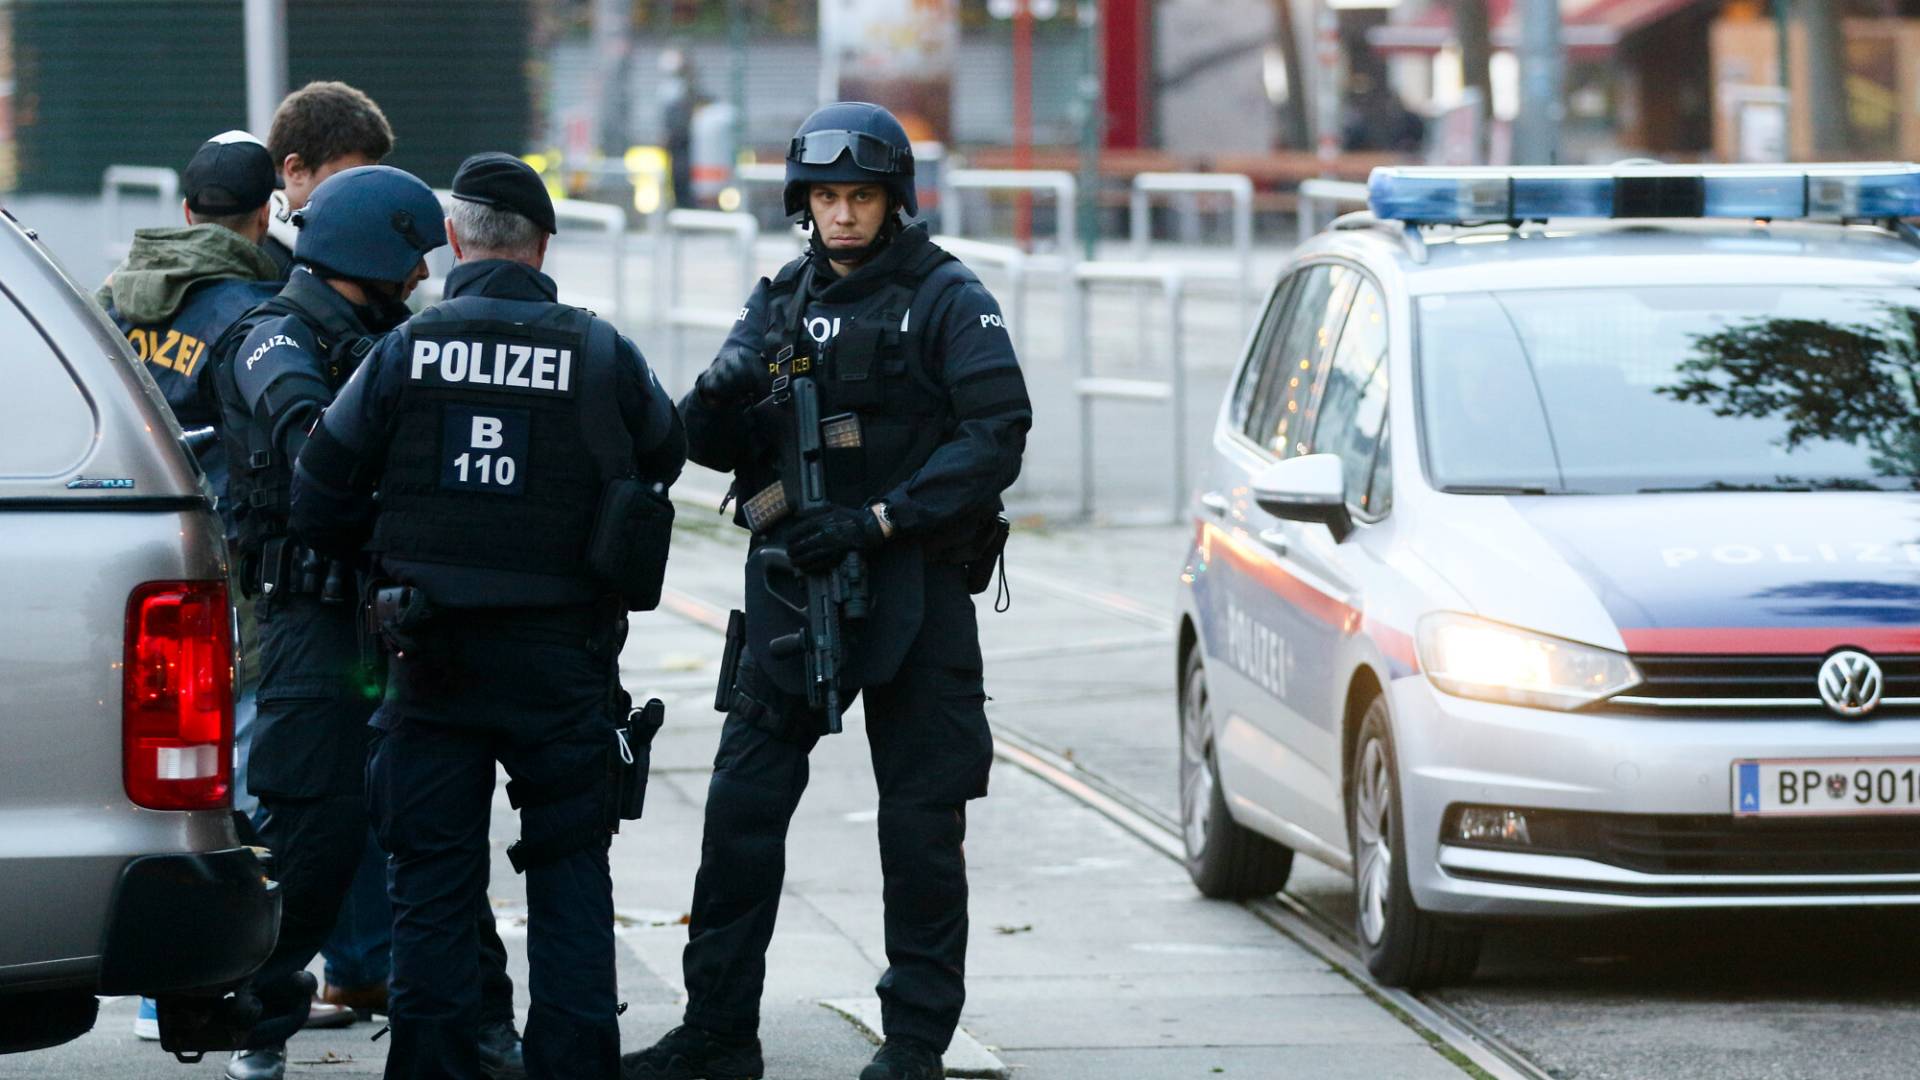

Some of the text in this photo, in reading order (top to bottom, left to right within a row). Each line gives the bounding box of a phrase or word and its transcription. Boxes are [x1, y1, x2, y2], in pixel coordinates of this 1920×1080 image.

[246, 334, 300, 370] POLIZEI
[411, 340, 572, 391] POLIZEI
[769, 356, 810, 375] PIZEI
[470, 415, 504, 449] B
[453, 452, 516, 486] 110
[1226, 602, 1286, 699] POLIZEI
[1779, 770, 1822, 804] BP
[1853, 768, 1920, 804] 901
